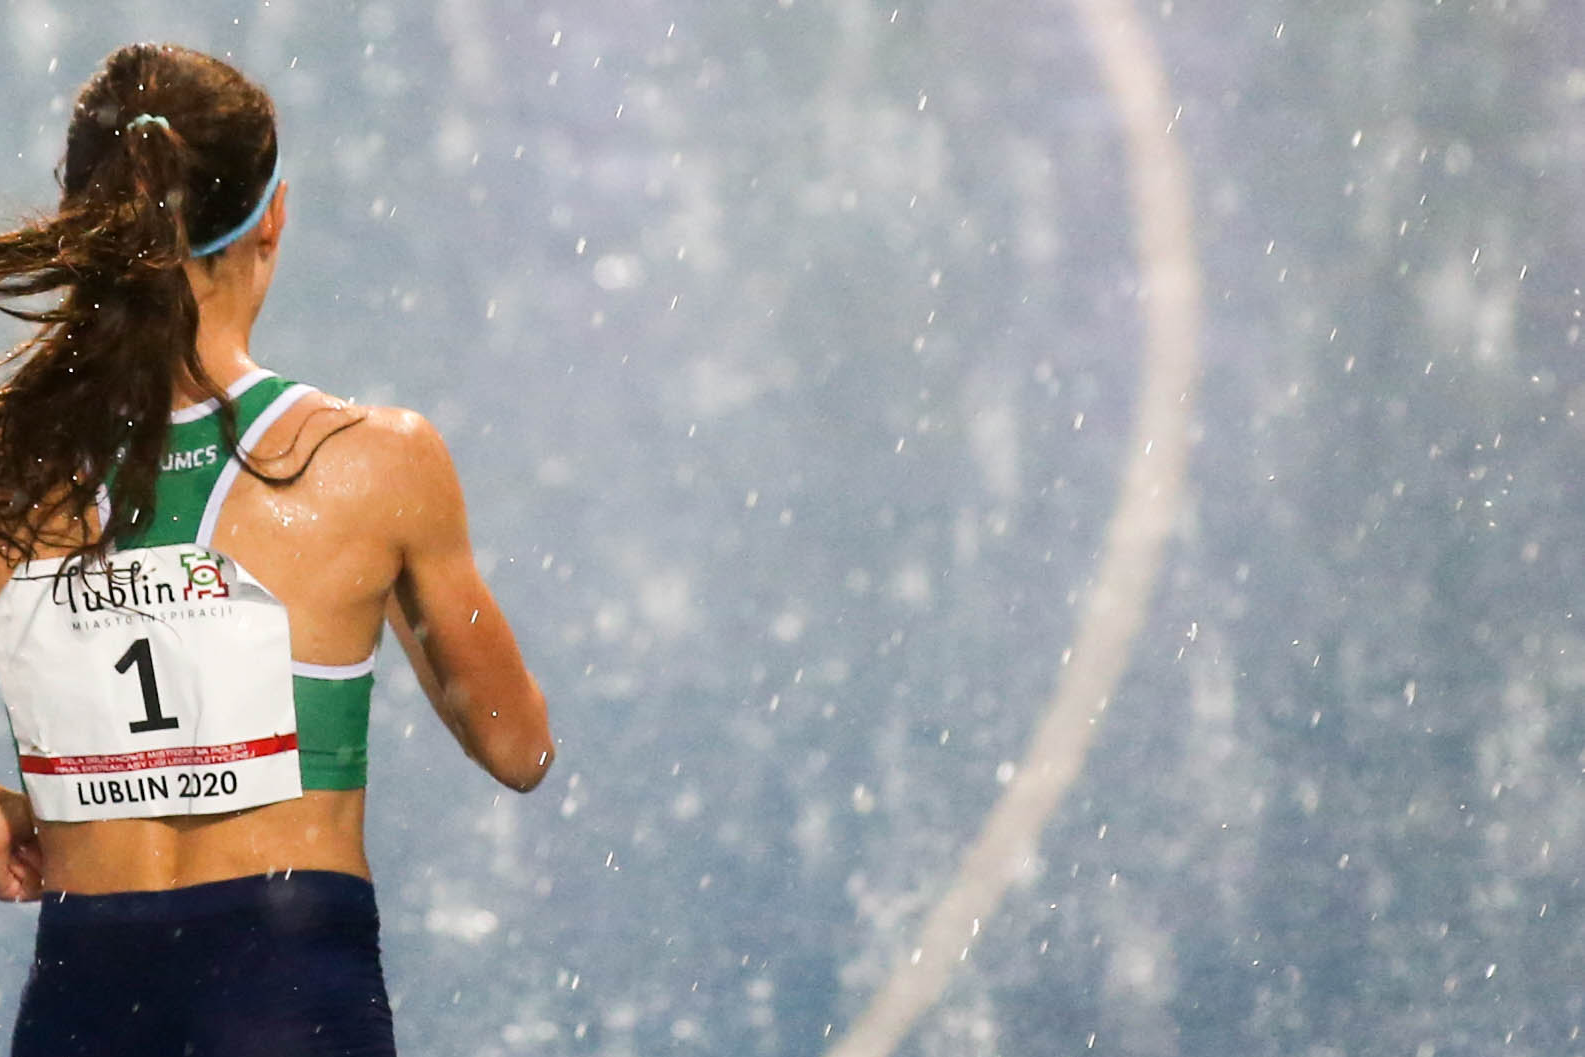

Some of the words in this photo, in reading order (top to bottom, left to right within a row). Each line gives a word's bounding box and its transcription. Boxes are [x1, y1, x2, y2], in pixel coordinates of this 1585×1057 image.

[72, 613, 133, 631] MIASTO
[114, 637, 180, 734] 1
[77, 775, 169, 806] LUBLIN
